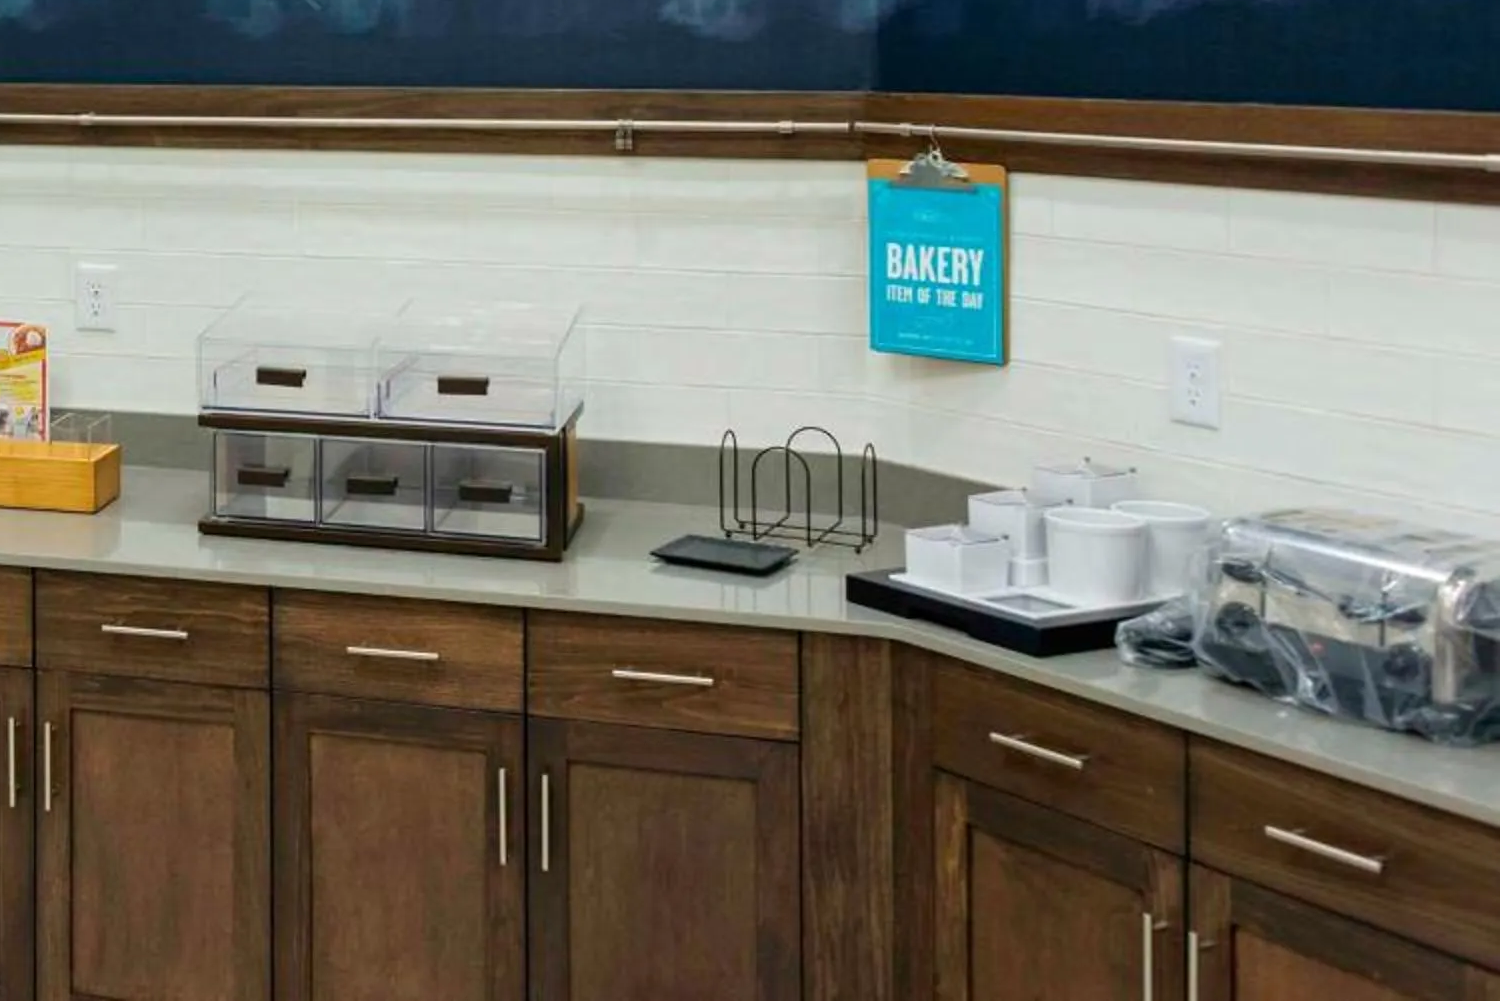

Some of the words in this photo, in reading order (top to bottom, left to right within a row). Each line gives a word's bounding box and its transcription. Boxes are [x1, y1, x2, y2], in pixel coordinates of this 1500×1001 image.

[885, 242, 985, 286] BAKERY
[886, 285, 913, 302] ITEM
[917, 286, 931, 305] OF
[936, 288, 957, 307] THE
[961, 291, 984, 310] DAY
